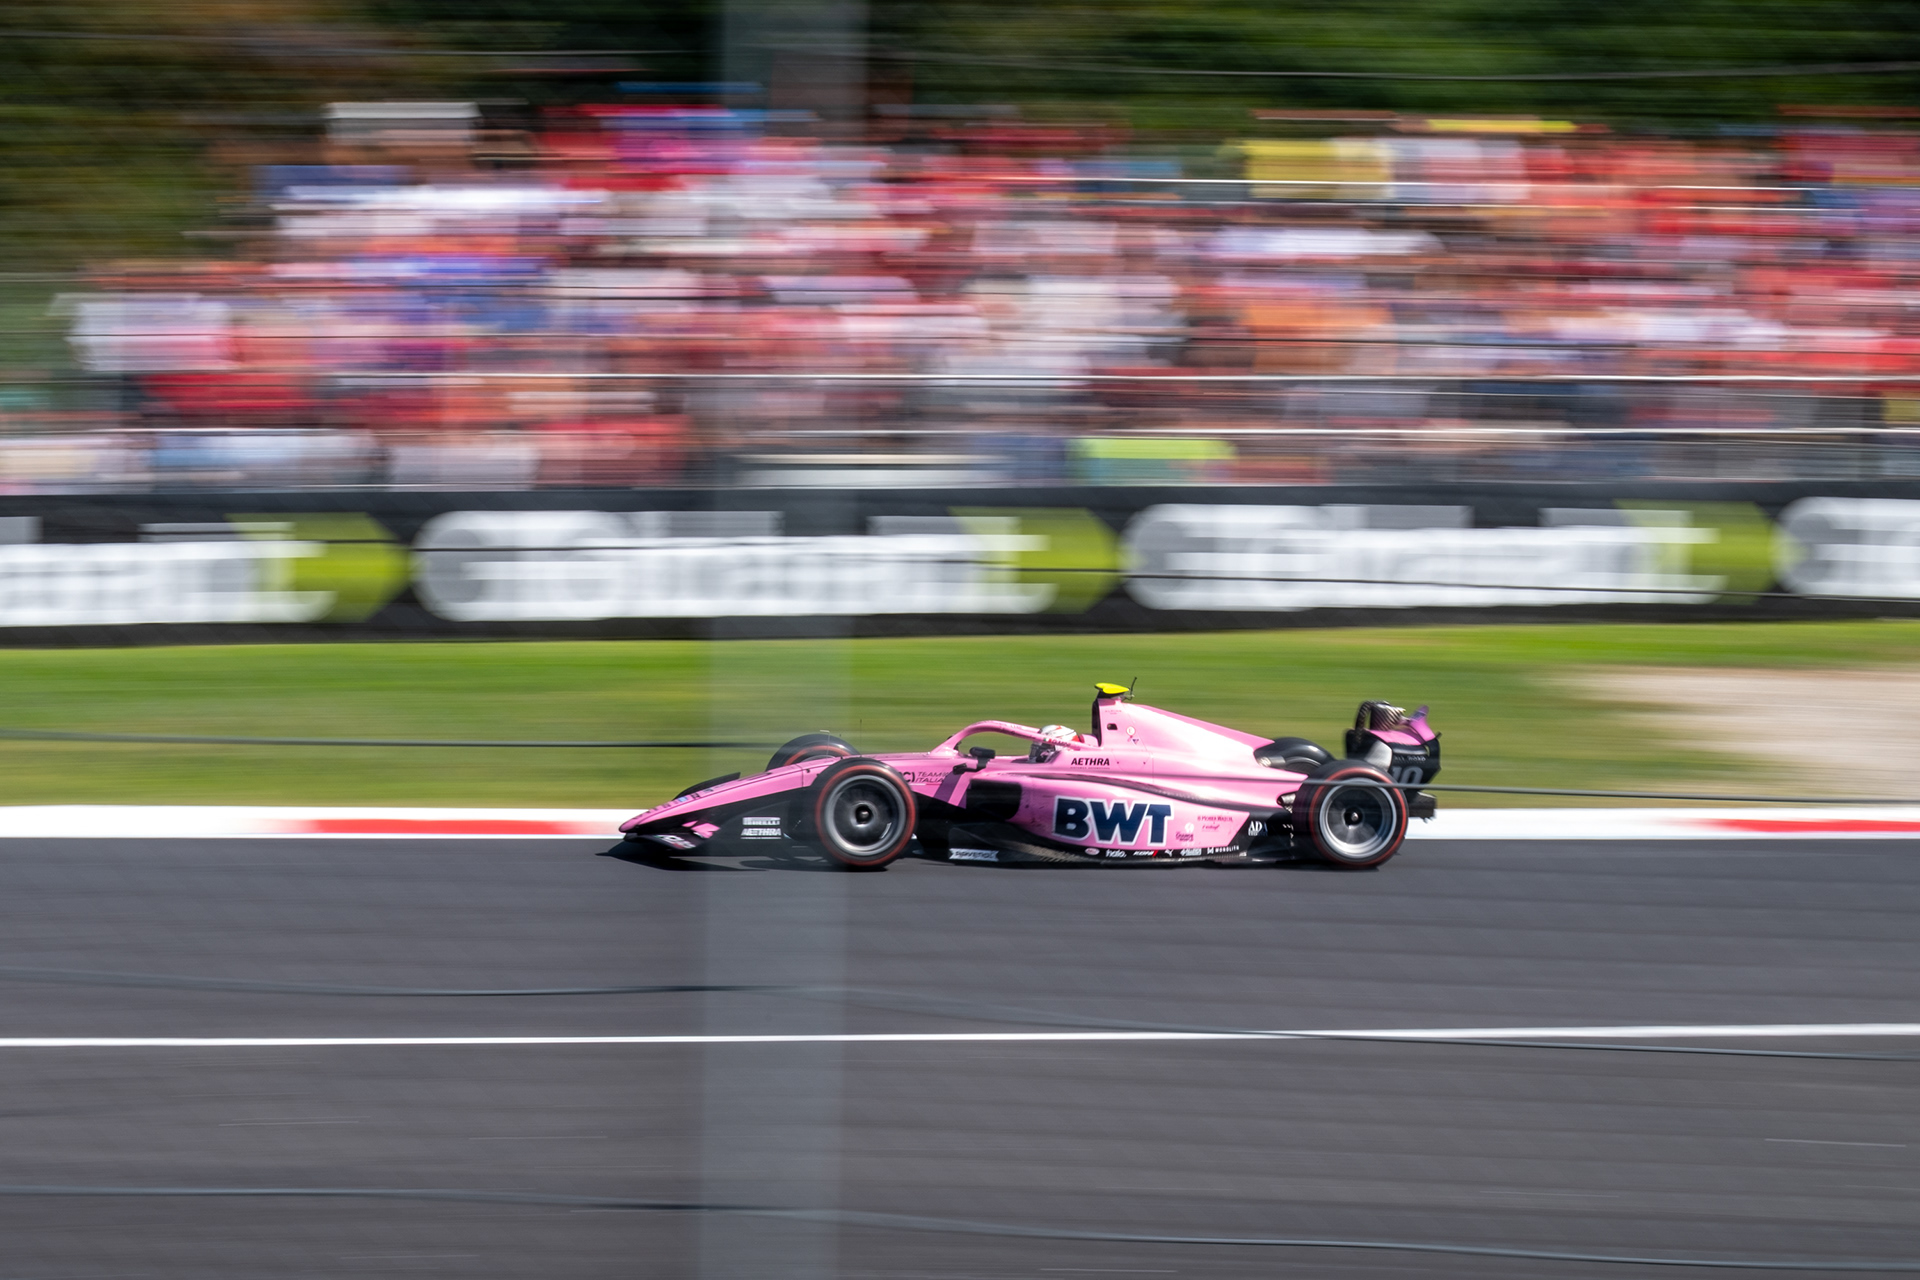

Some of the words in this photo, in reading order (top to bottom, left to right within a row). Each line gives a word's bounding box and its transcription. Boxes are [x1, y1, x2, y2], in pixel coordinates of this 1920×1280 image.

[1071, 757, 1110, 766] AETHRA
[1392, 766, 1424, 786] 10
[1053, 796, 1174, 846] BWT
